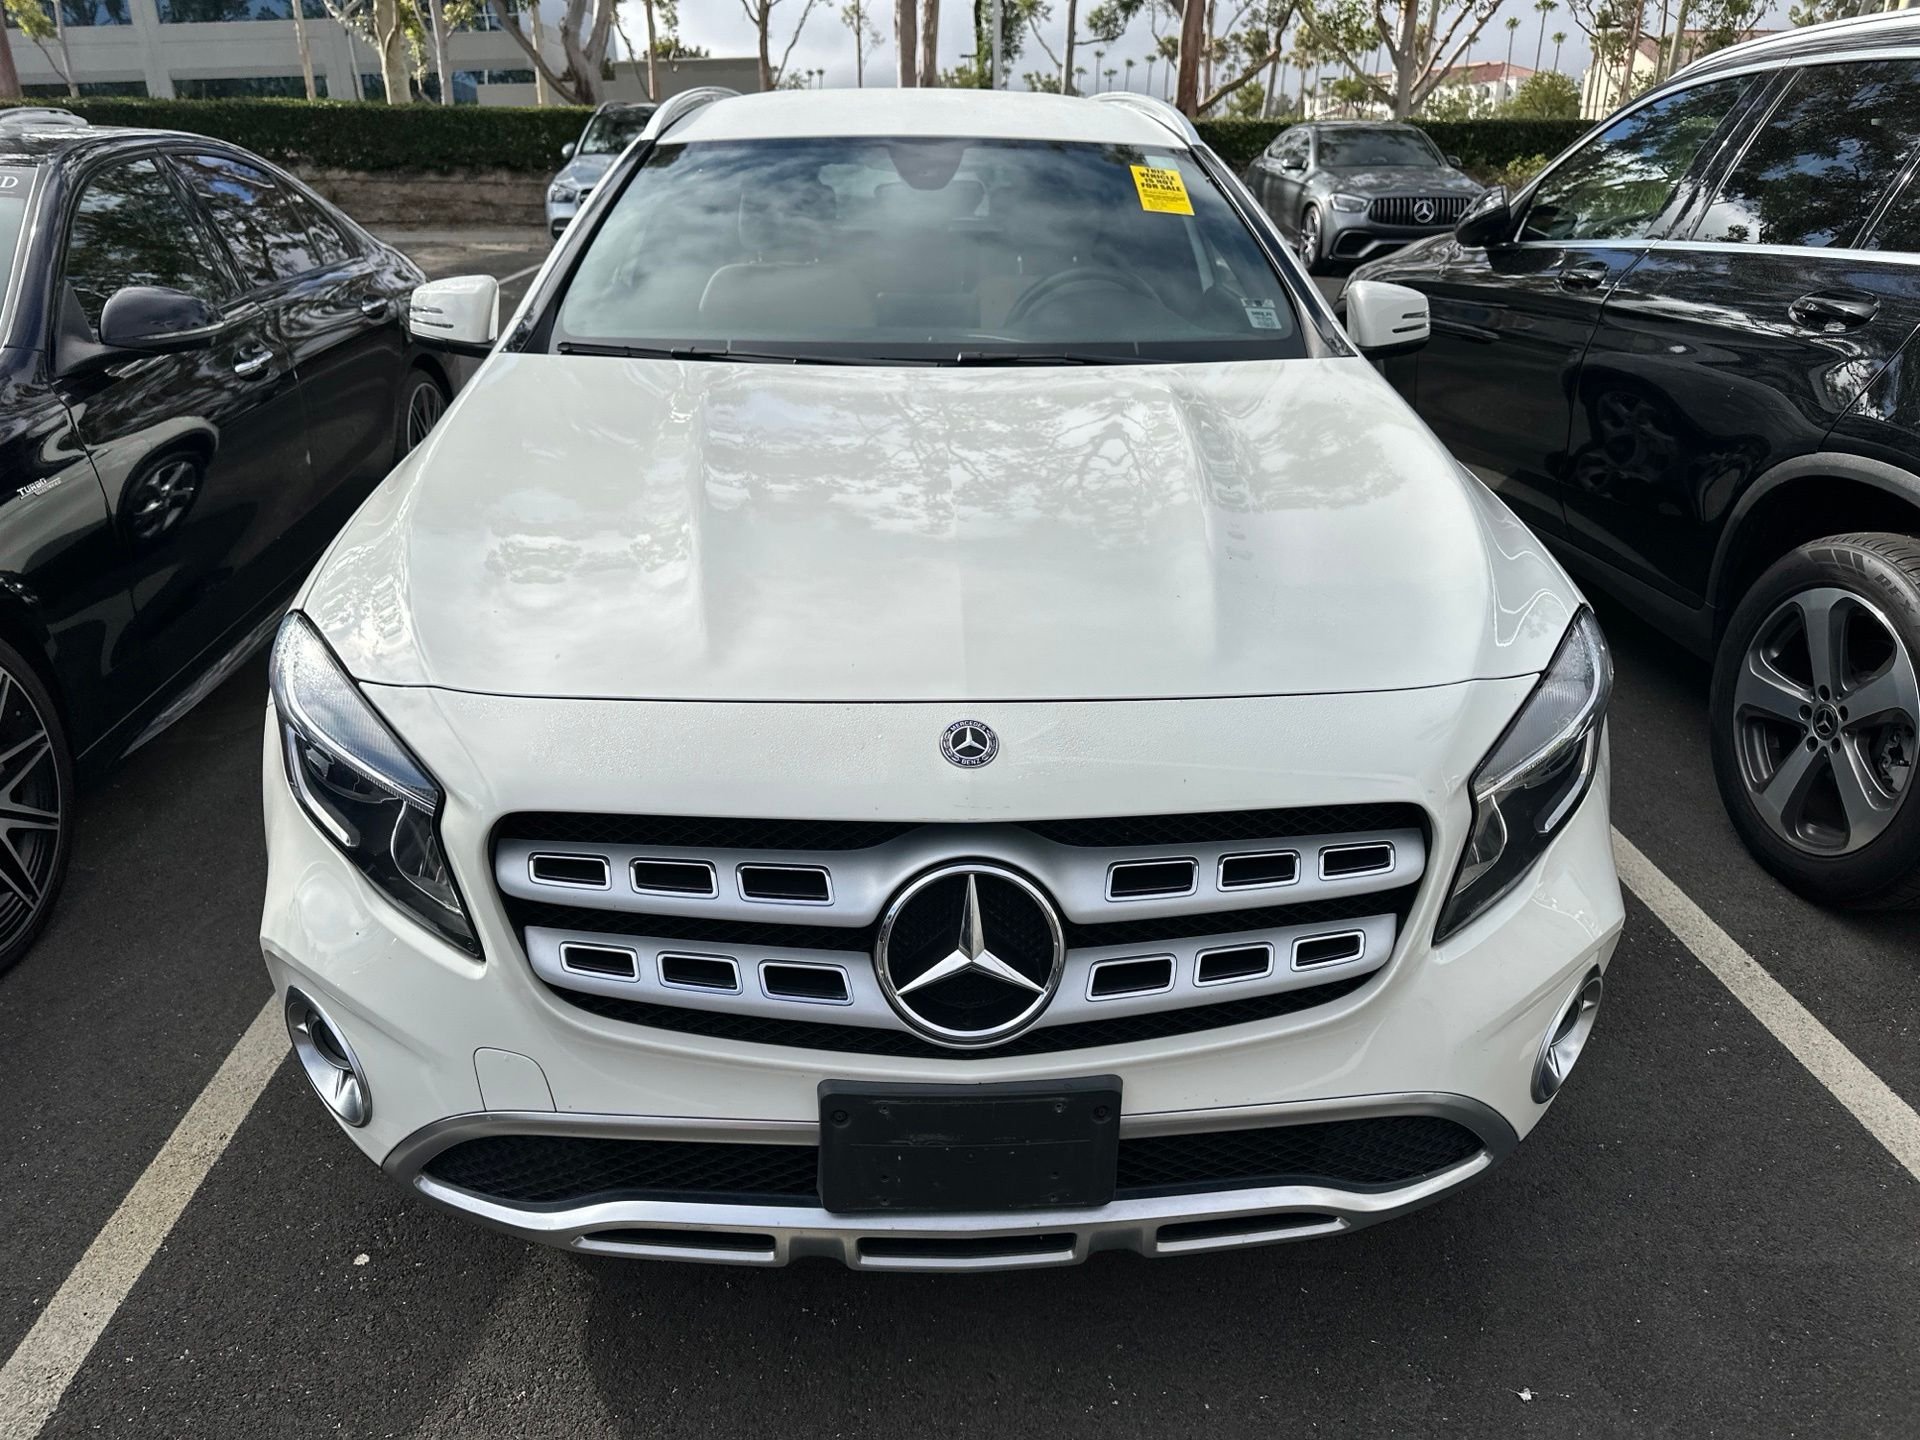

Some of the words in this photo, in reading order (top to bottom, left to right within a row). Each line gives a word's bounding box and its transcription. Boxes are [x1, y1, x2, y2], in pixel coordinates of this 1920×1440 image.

[1139, 171, 1176, 181] VEHICLE
[1159, 184, 1182, 192] SALE
[16, 477, 48, 497] TURBO
[950, 720, 987, 731] MERCEDES
